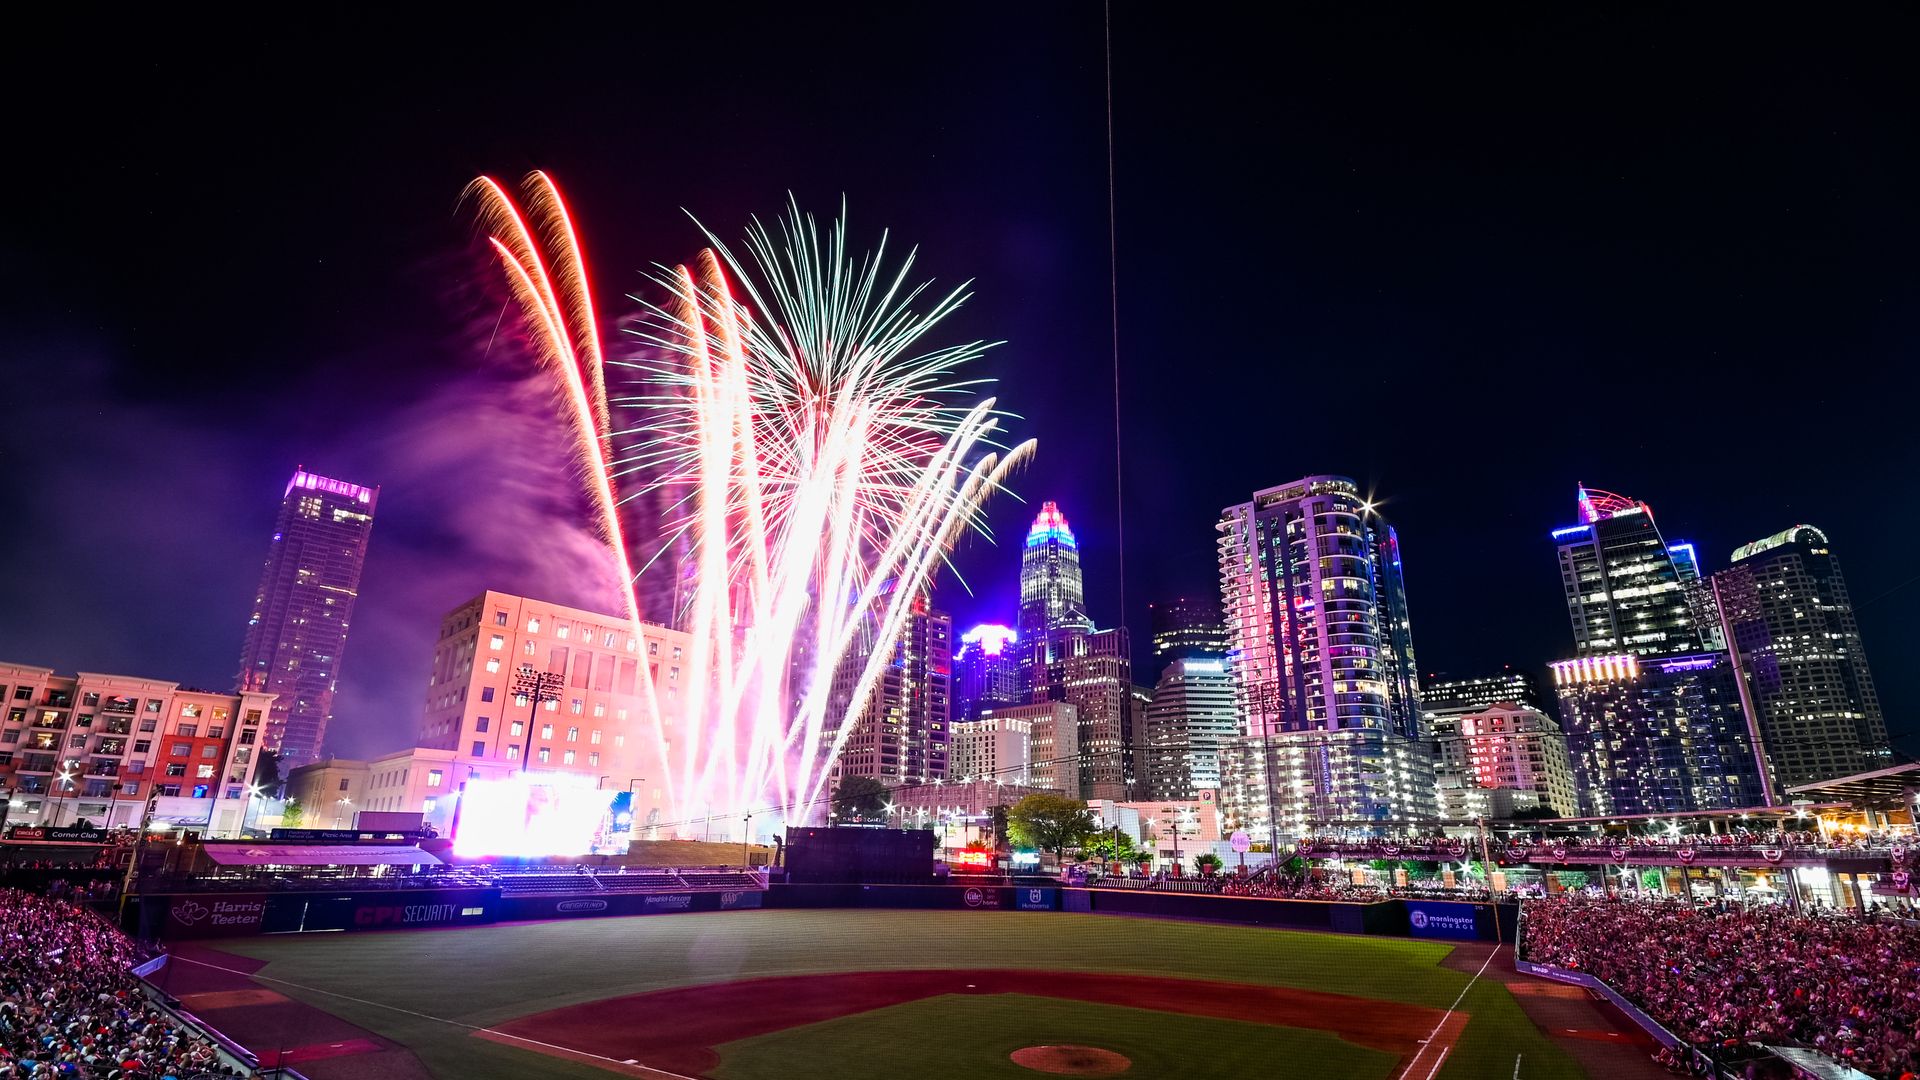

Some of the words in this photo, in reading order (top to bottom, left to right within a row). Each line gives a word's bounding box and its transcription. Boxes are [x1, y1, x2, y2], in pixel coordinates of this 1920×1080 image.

[80, 832, 98, 840] Club
[1382, 853, 1400, 861] Home
[1412, 854, 1430, 862] Porch
[212, 901, 261, 912] Harris
[356, 907, 402, 924] CPI
[403, 904, 457, 922] SECURITY
[211, 914, 258, 925] Teeter
[1429, 915, 1473, 925] morningstar
[1430, 922, 1474, 930] STORAGE
